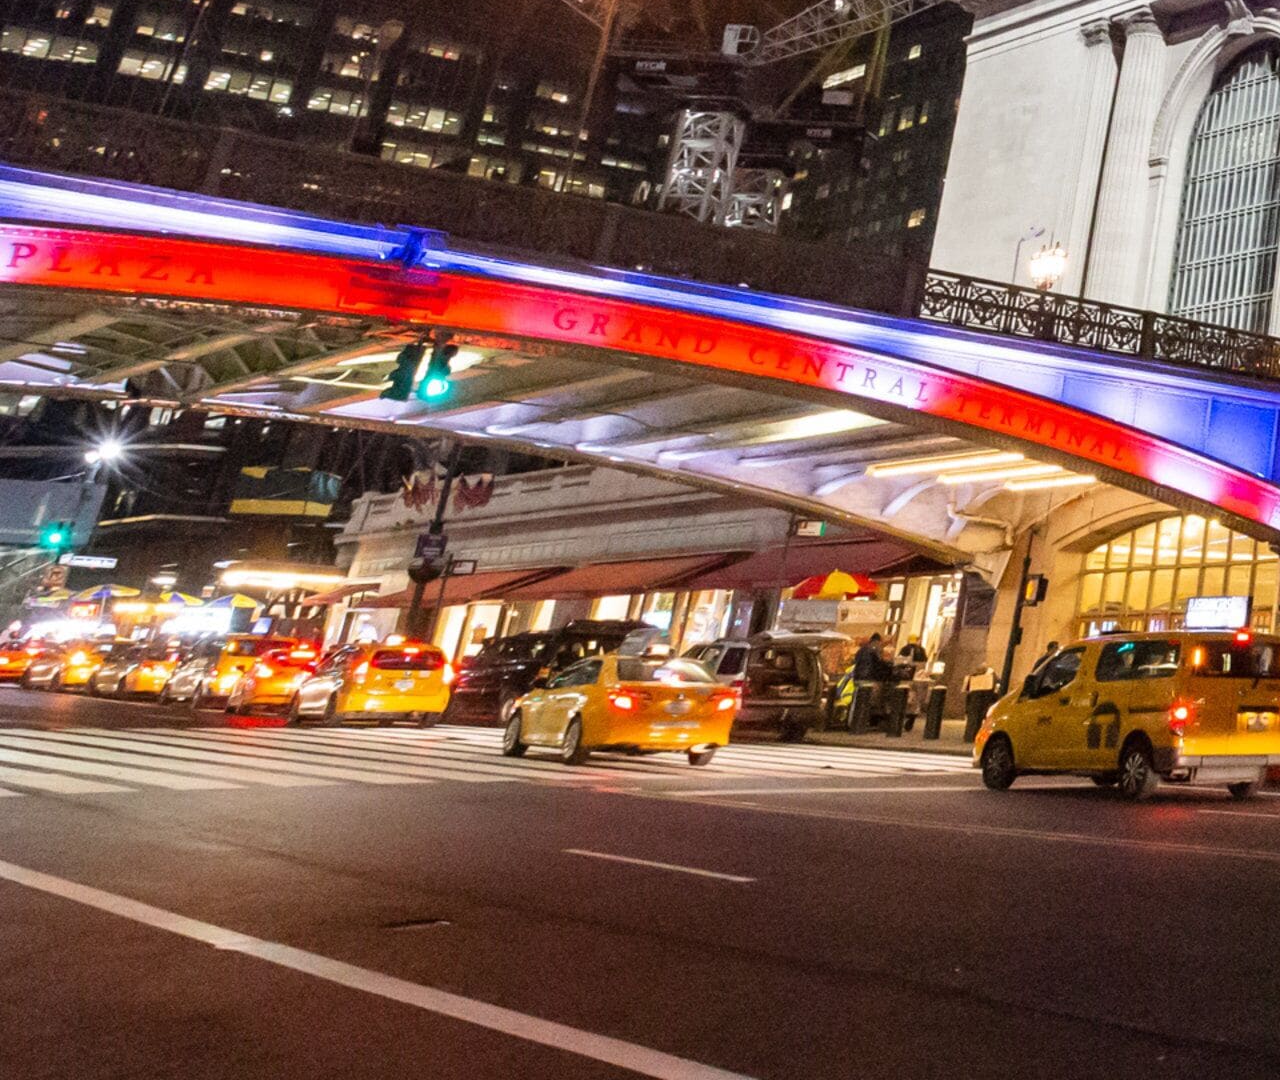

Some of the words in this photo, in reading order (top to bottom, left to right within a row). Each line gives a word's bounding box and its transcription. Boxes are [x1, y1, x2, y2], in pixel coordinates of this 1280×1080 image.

[6, 242, 215, 285] PLAZA
[553, 308, 718, 354] GRAND
[749, 342, 929, 402] CENTRAL
[956, 394, 1124, 462] TERMINAL
